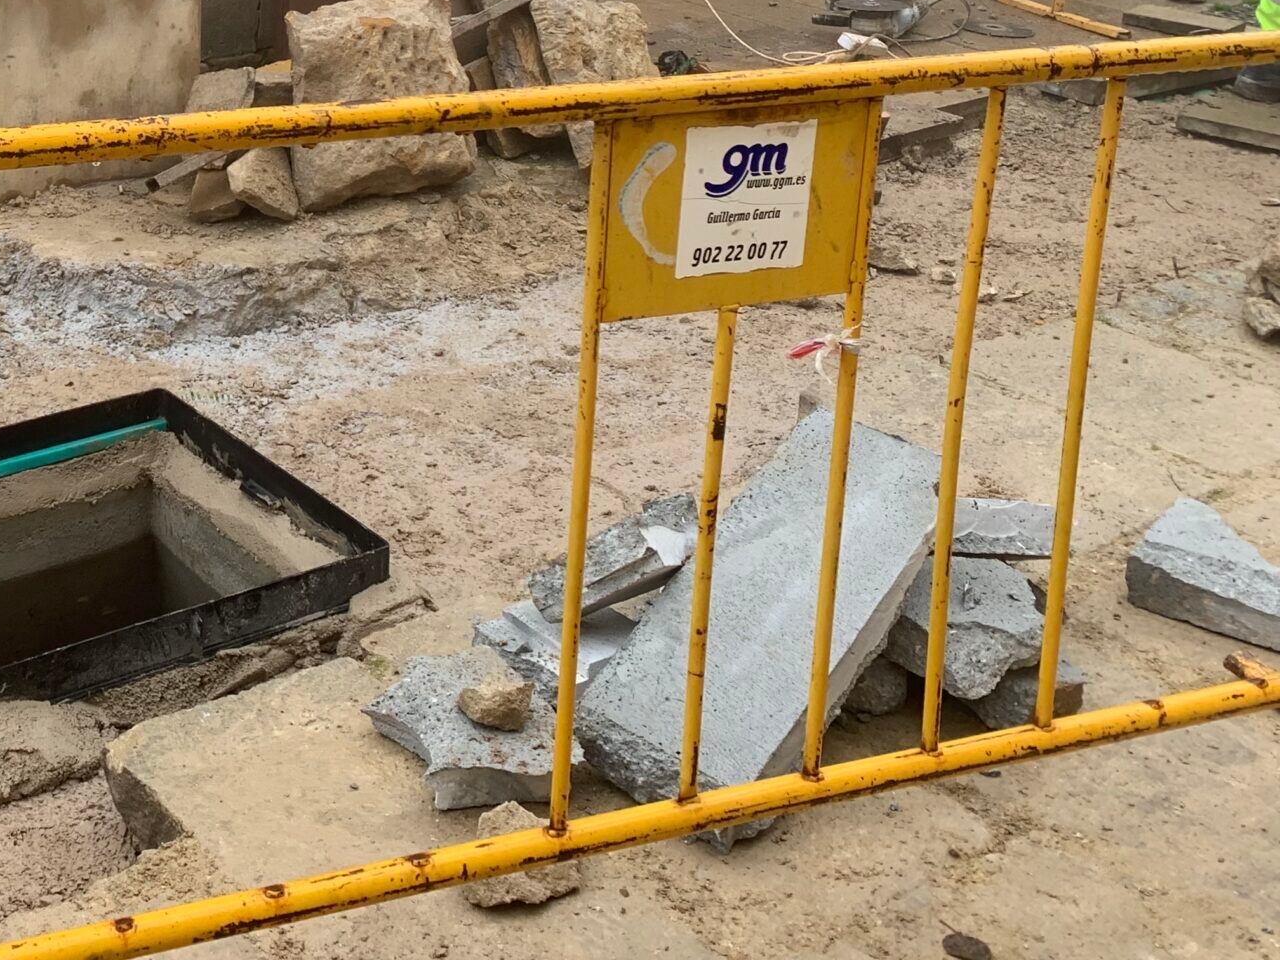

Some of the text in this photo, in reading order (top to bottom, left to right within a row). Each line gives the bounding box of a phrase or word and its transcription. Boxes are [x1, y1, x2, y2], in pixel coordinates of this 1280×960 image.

[704, 142, 789, 198] gm
[746, 175, 806, 190] www.ggm.es
[707, 207, 781, 224] Guillermo García
[691, 240, 788, 267] 902 22 00 77
